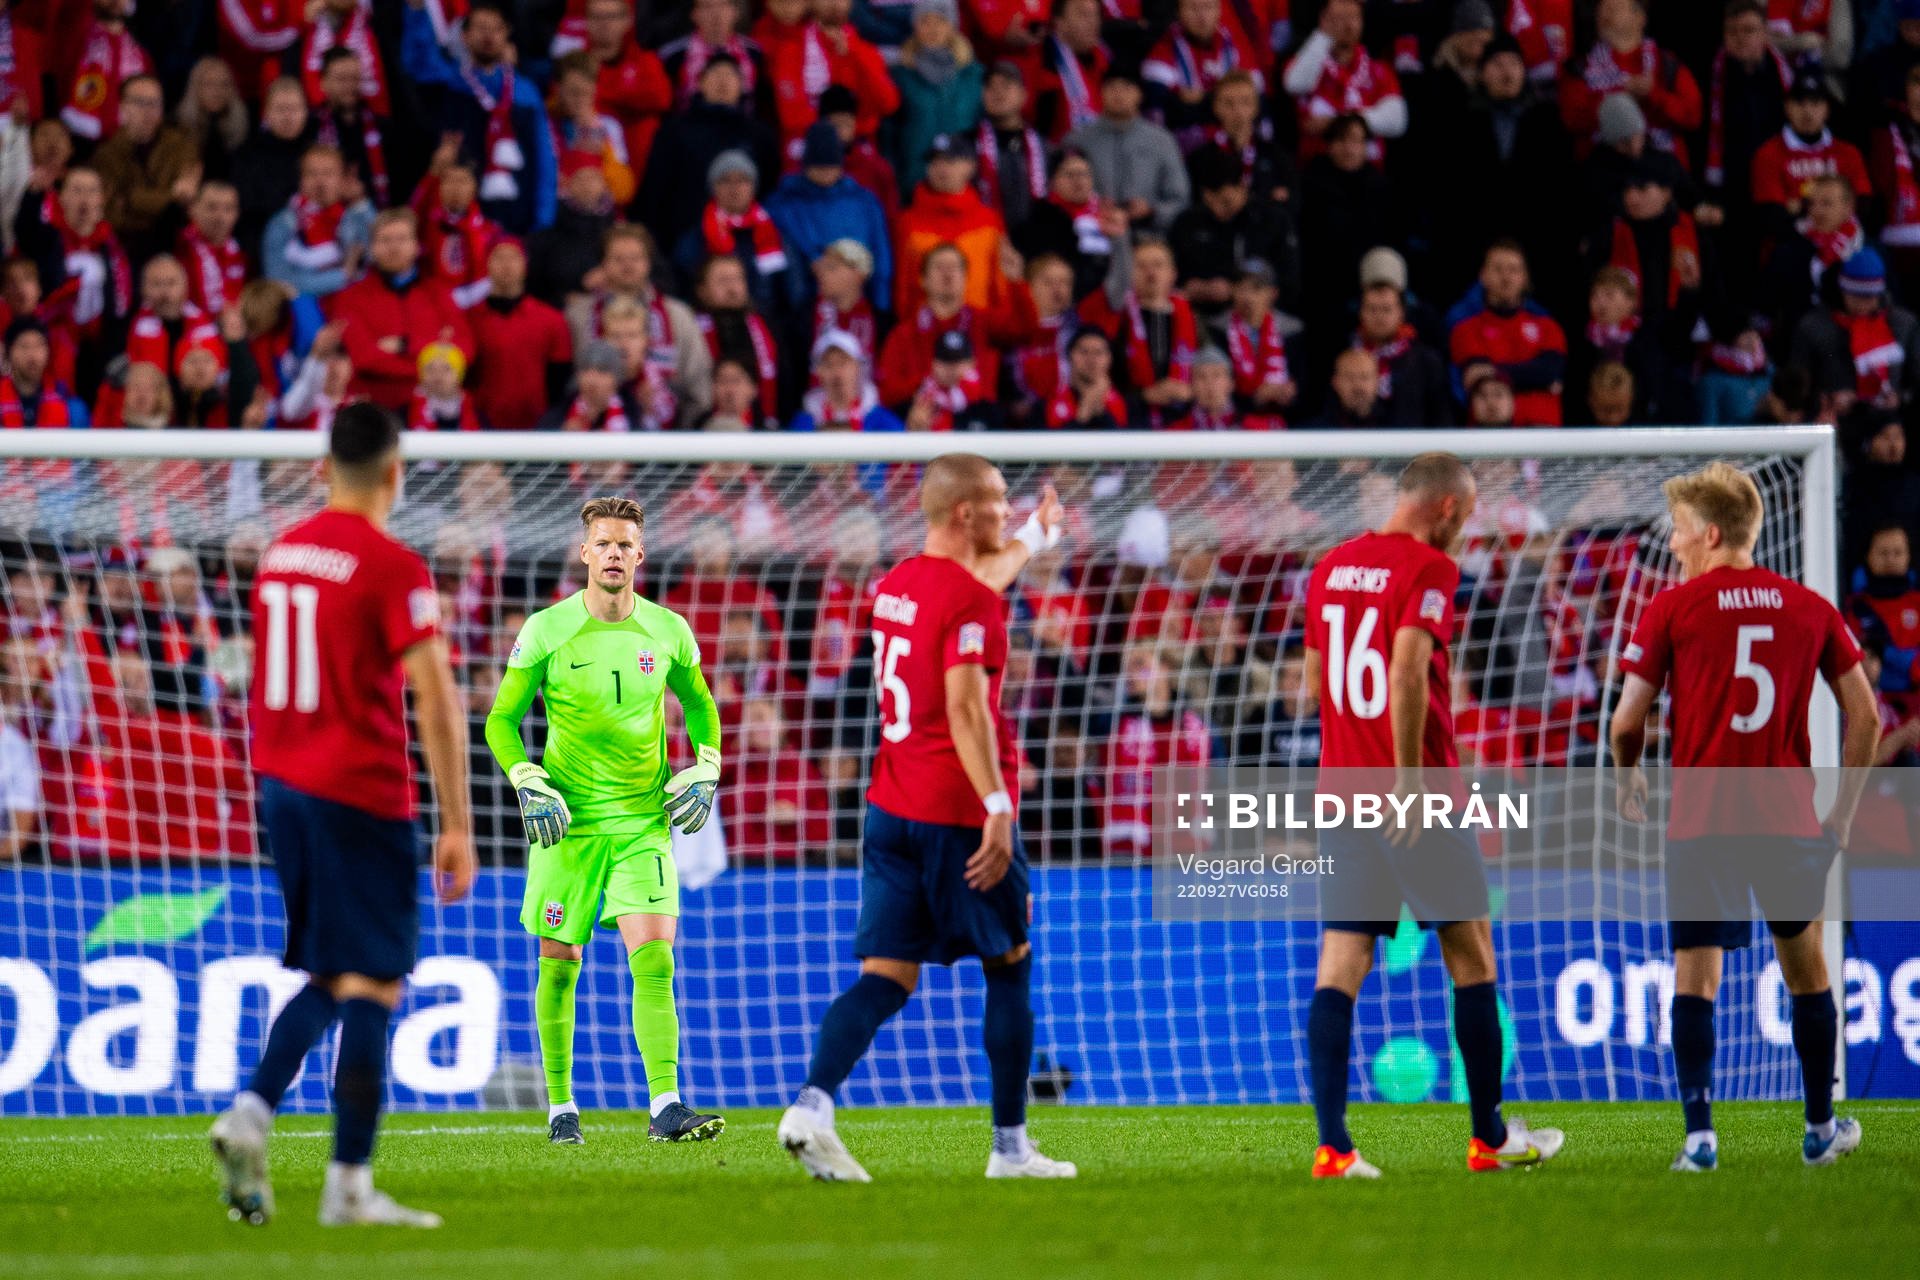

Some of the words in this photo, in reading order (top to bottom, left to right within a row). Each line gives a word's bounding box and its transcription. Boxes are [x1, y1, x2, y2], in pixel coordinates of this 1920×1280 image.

[1718, 586, 1783, 610] MELING
[259, 581, 320, 713] 11
[1321, 604, 1387, 719] 16
[1730, 625, 1775, 733] 5
[611, 670, 621, 704] 1
[655, 856, 664, 886] 1
